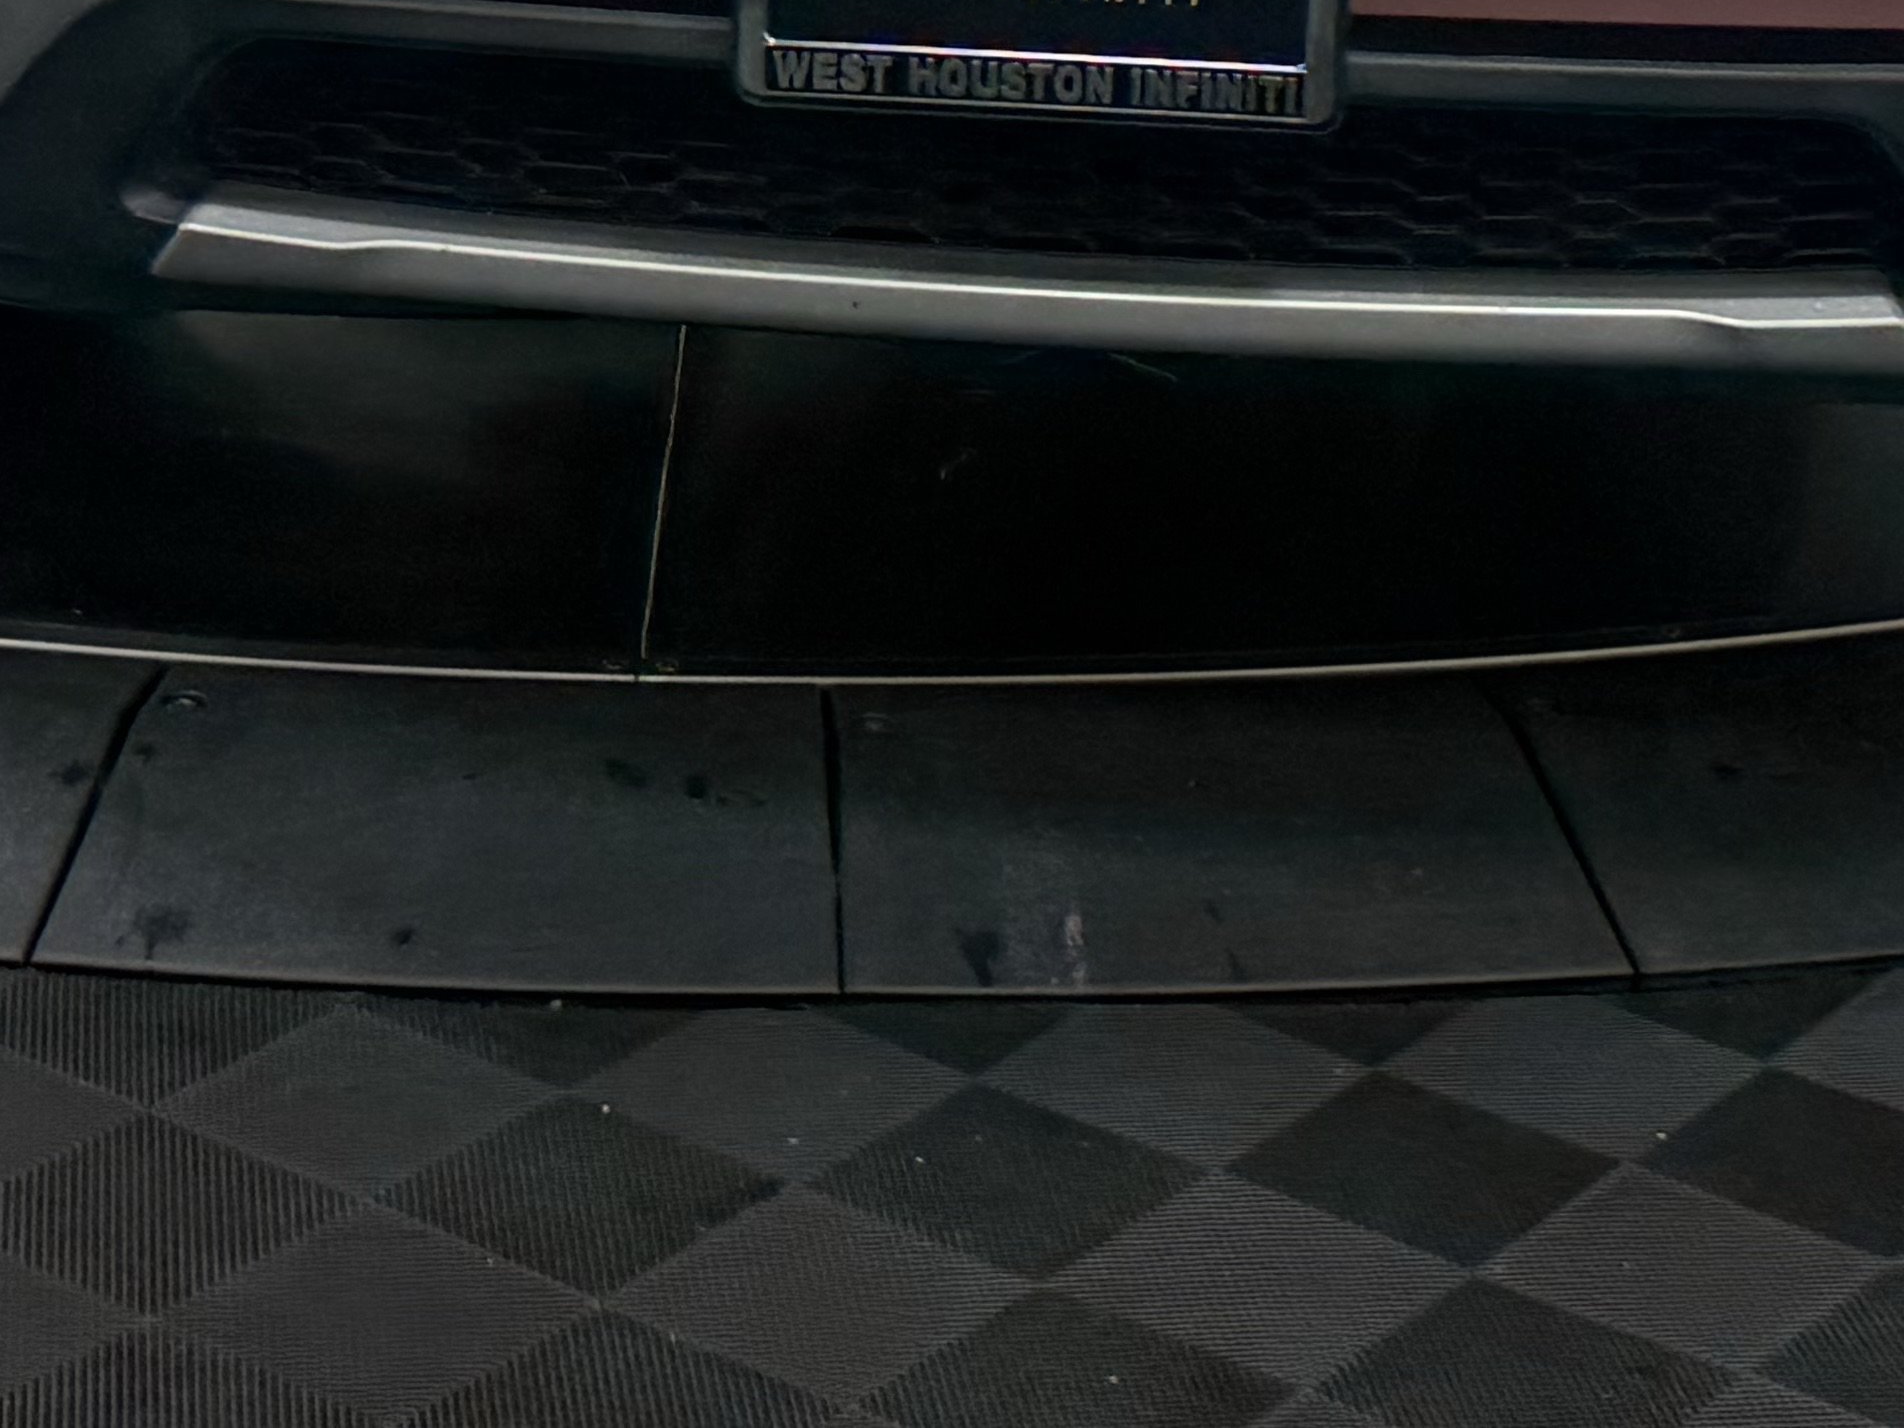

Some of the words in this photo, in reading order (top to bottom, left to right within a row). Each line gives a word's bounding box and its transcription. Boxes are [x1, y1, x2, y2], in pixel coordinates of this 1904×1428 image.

[771, 48, 894, 94] WEST
[907, 54, 1115, 106] HOUSTON
[1129, 65, 1299, 116] INFINITI
